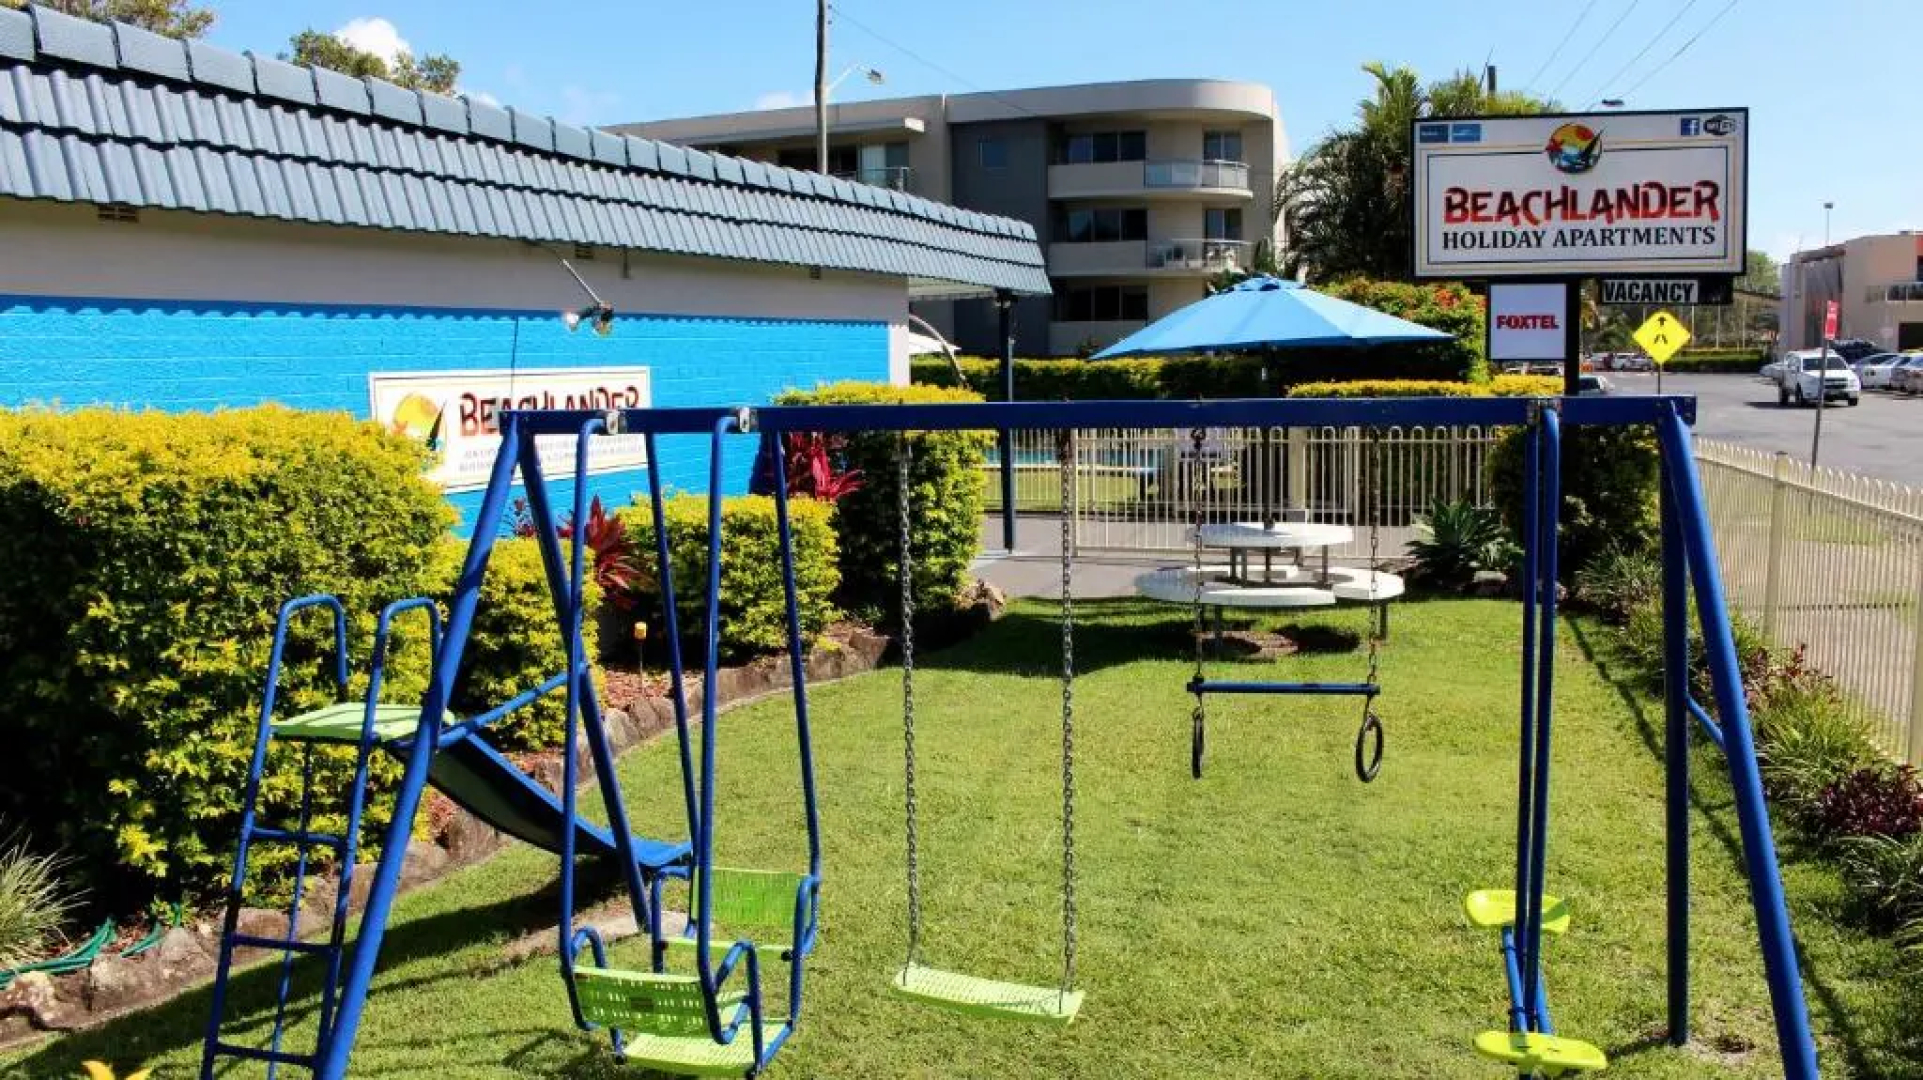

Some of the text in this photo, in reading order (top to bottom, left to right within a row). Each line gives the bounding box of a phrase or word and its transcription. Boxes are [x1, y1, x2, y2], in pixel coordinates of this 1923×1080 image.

[1444, 180, 1720, 226] BEACHLANDER
[1442, 226, 1716, 250] HOLIDAY APARTMENTS
[1603, 280, 1694, 303] VACANCY
[1496, 315, 1560, 330] FOXTEL
